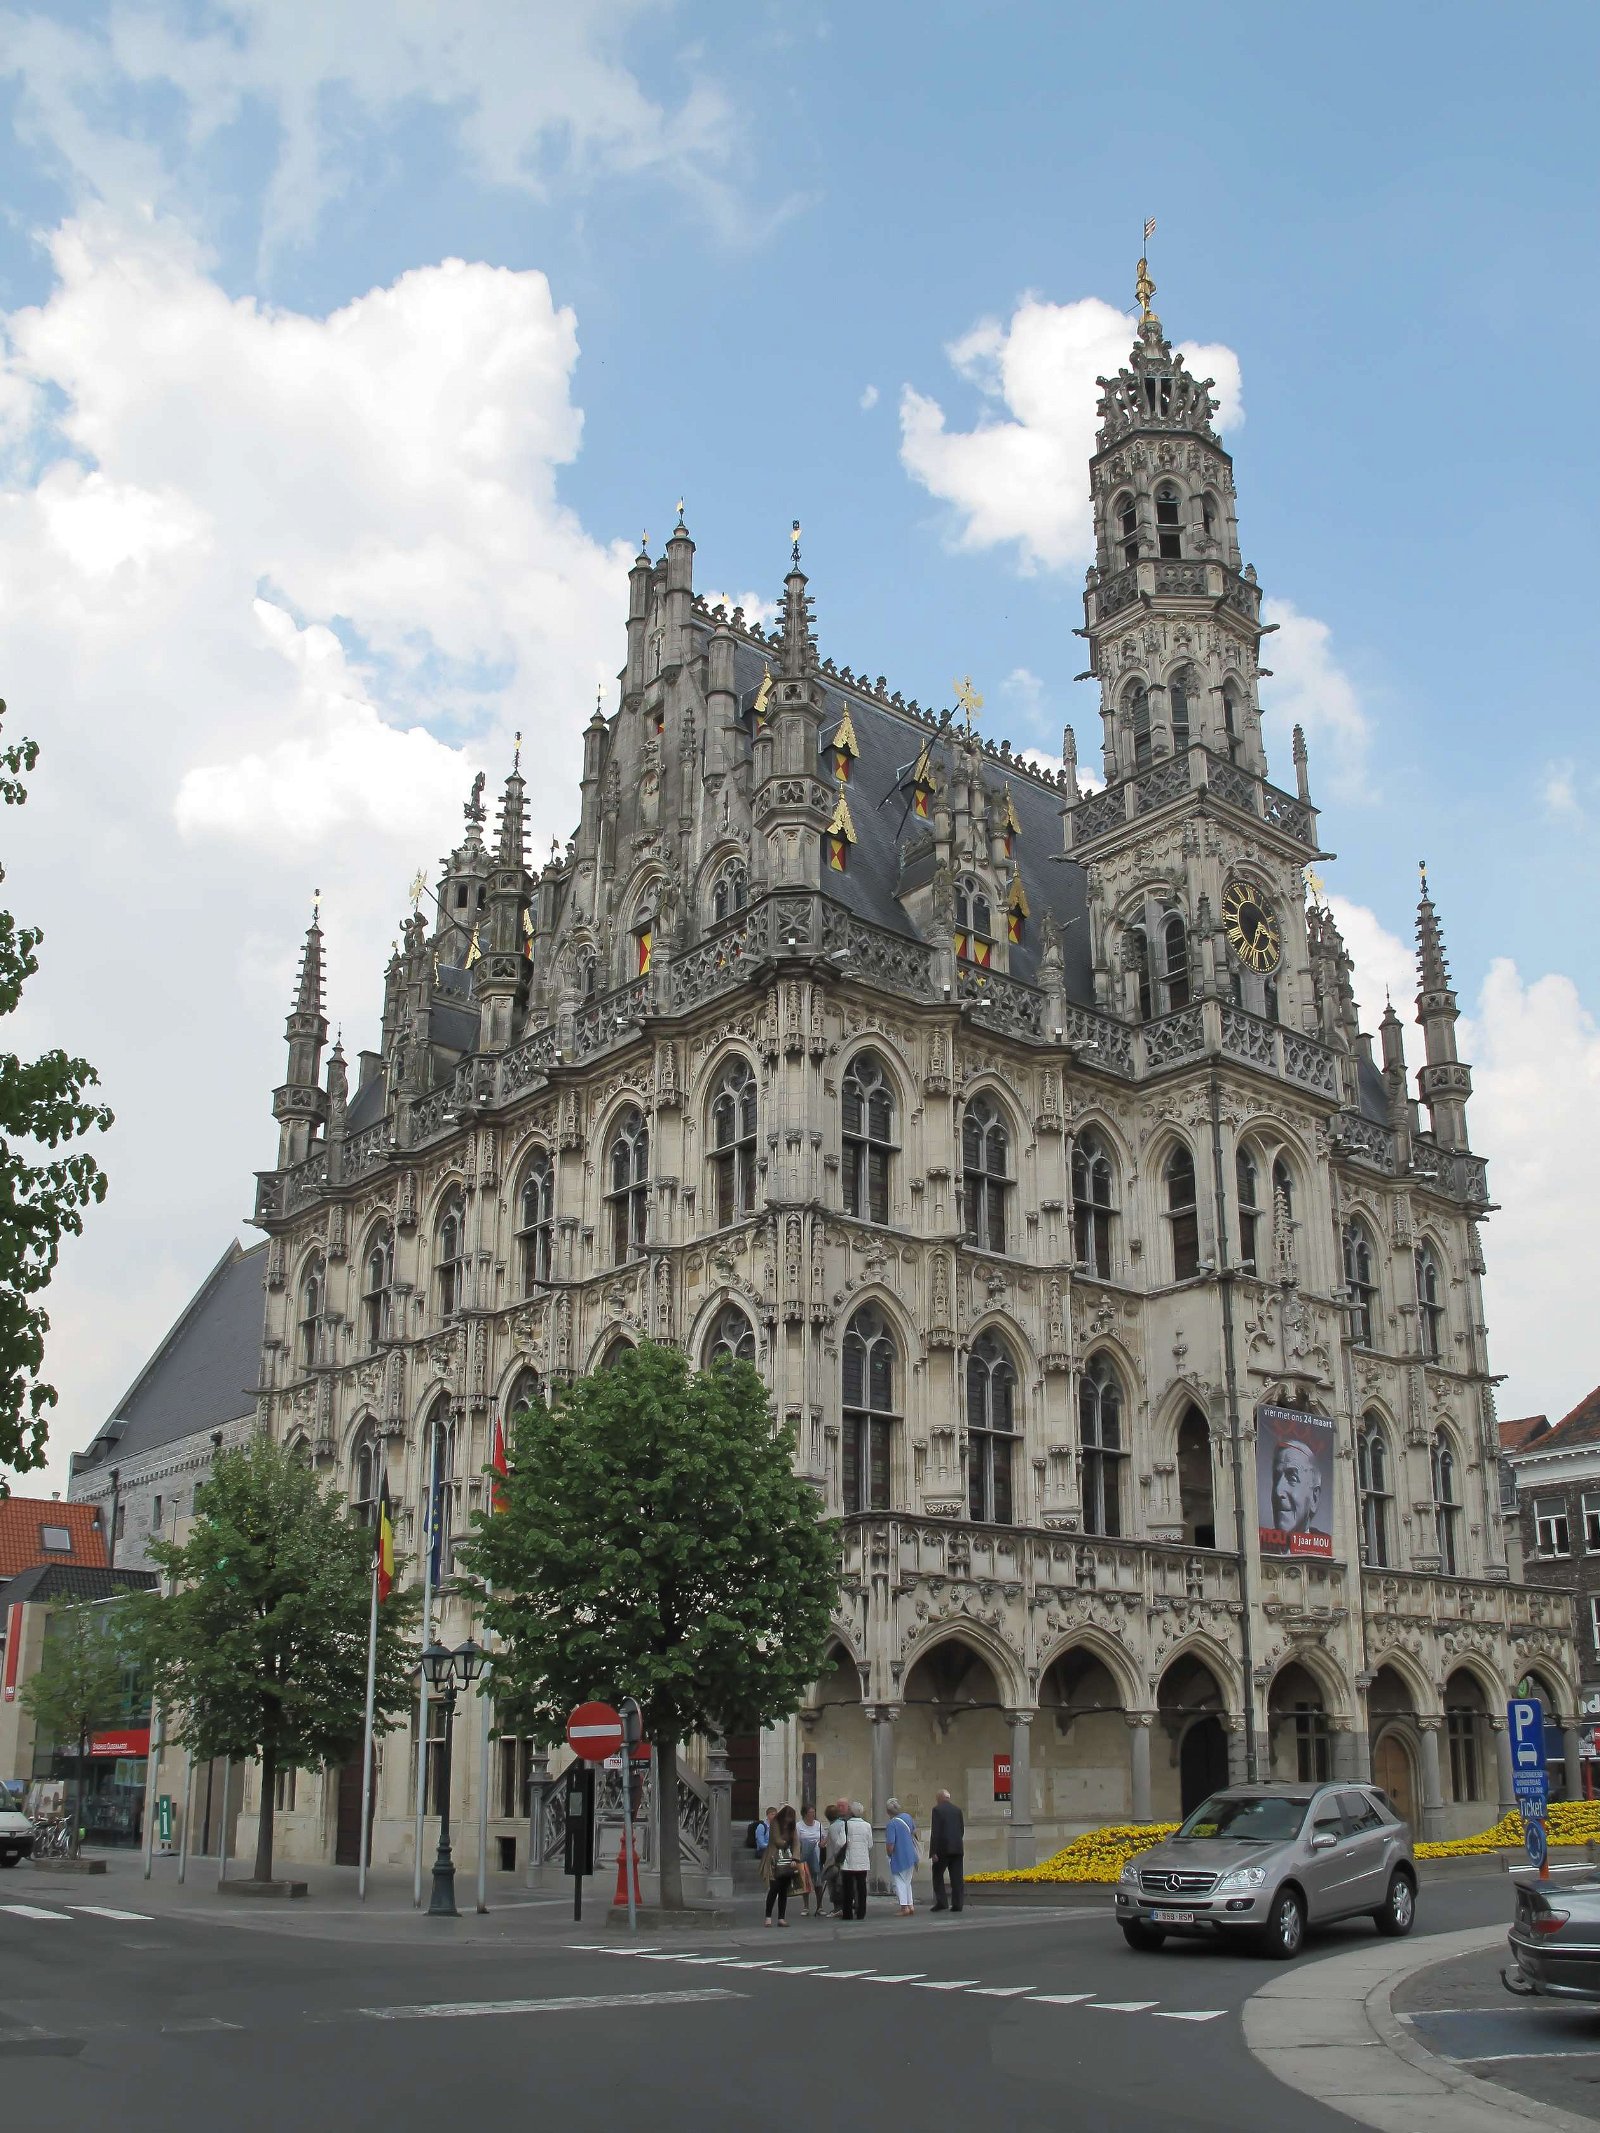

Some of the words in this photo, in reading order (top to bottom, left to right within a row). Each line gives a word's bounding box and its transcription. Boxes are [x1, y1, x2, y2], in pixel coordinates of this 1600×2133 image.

[1263, 1407, 1276, 1417] vier
[1277, 1411, 1290, 1420] met
[1291, 1414, 1303, 1423] ons
[1303, 1414, 1312, 1425] 24
[1312, 1418, 1333, 1429] maart
[1297, 1535, 1312, 1547] jaar
[1313, 1537, 1329, 1548] MOU
[1514, 1704, 1534, 1741] P
[1520, 1798, 1544, 1817] Ticket
